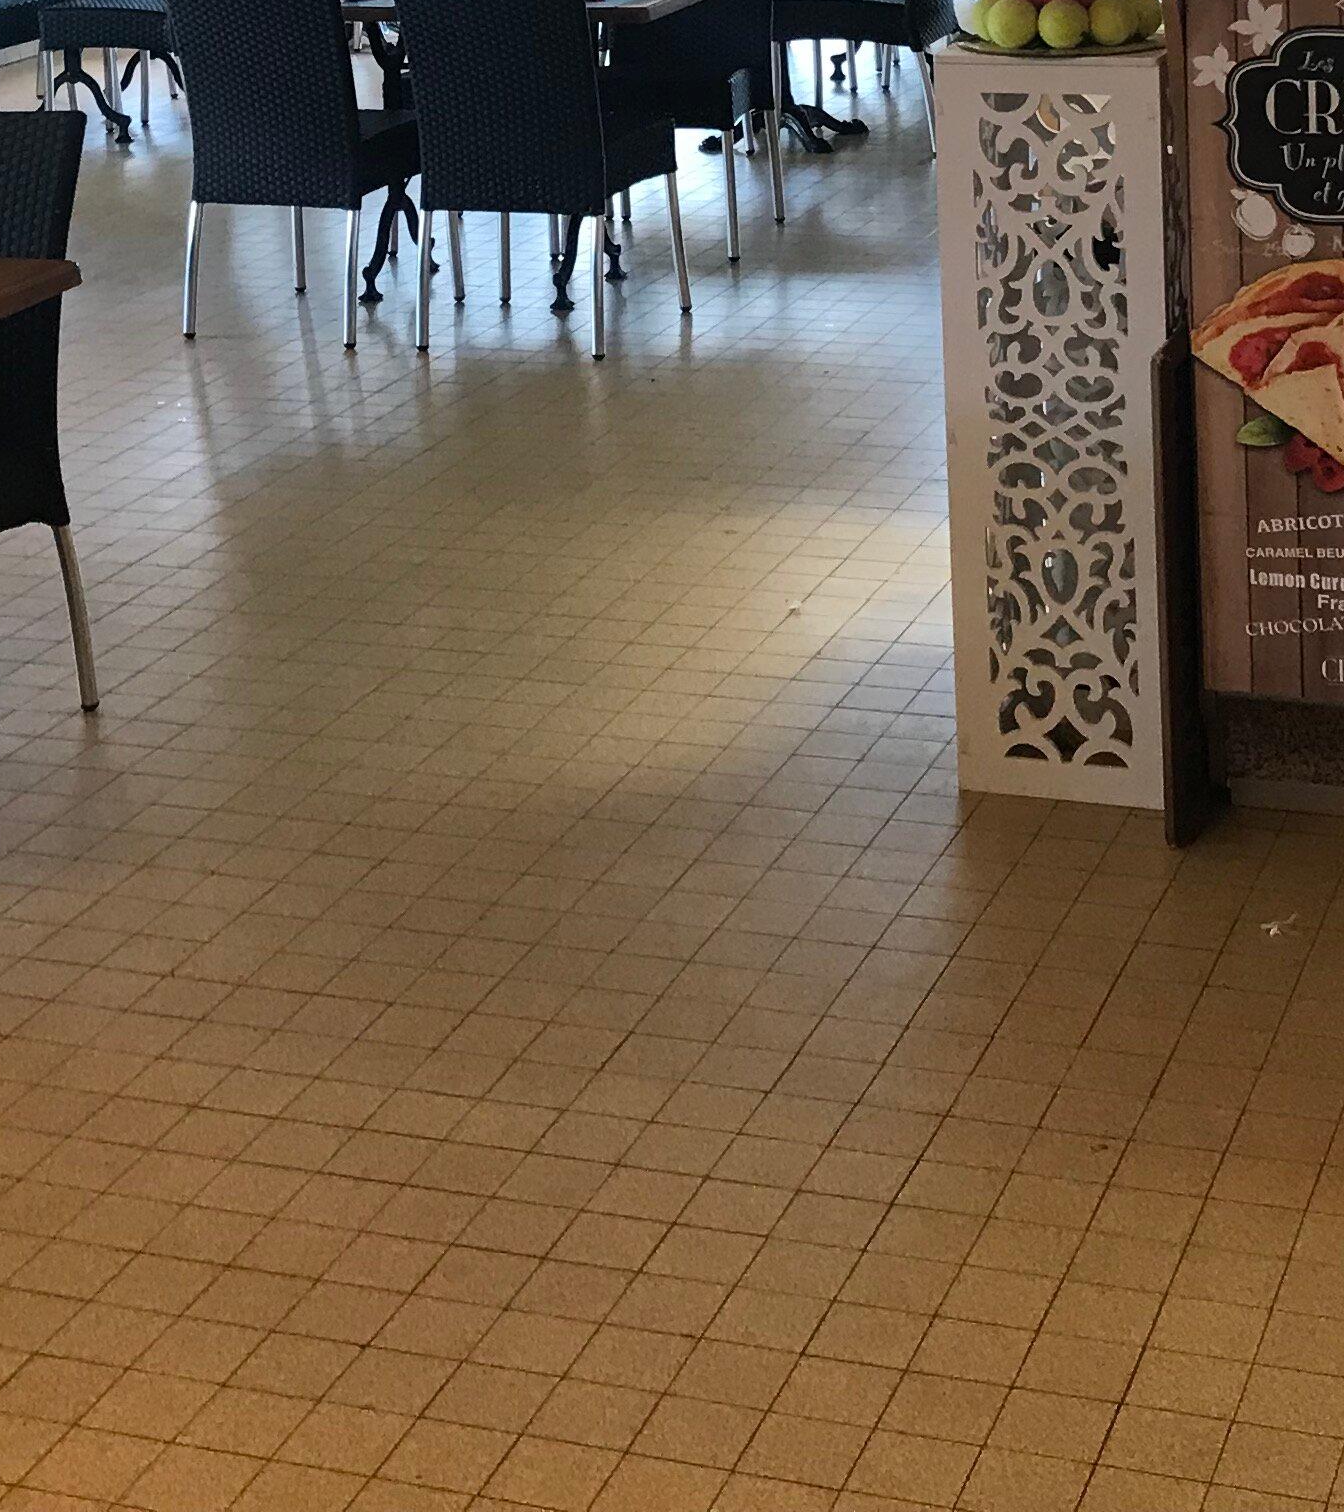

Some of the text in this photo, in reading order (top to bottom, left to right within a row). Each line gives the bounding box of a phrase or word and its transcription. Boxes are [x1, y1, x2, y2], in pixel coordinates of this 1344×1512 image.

[1298, 51, 1336, 73] Les
[1279, 143, 1317, 171] Un
[1313, 182, 1331, 204] et
[1257, 514, 1344, 534] ABRICOT
[1245, 547, 1313, 559] CARAMEL
[1249, 568, 1305, 589] Lemon
